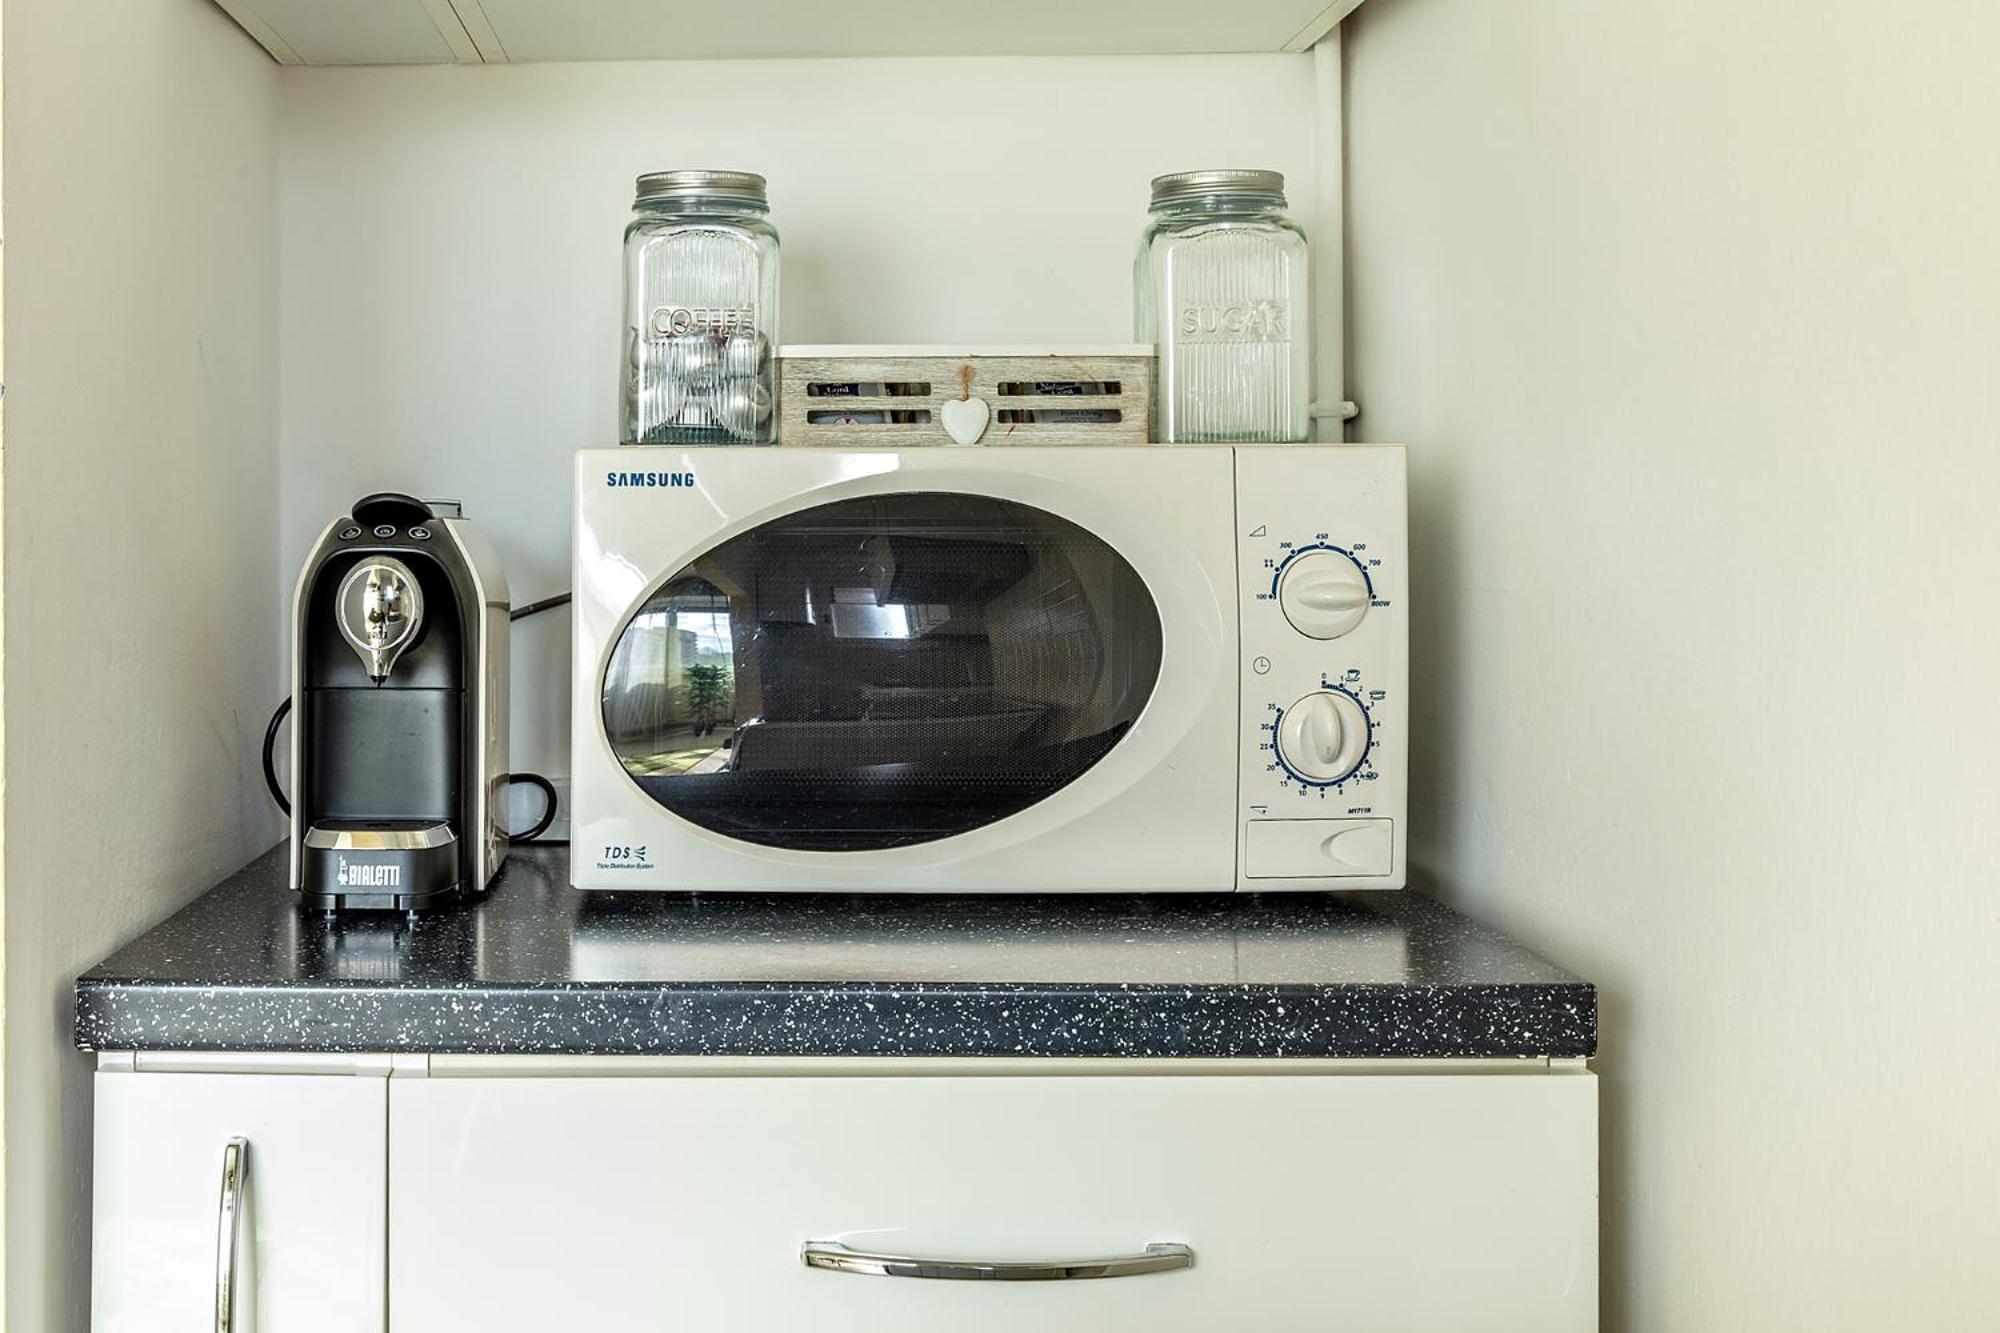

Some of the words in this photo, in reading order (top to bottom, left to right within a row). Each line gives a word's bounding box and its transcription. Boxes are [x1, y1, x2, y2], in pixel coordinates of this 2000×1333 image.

[652, 308, 754, 335] COFFEE
[1182, 306, 1287, 335] SUGAR
[607, 472, 694, 487] SAMSUNG
[605, 846, 630, 859] TDS
[349, 864, 400, 886] BIALETTI
